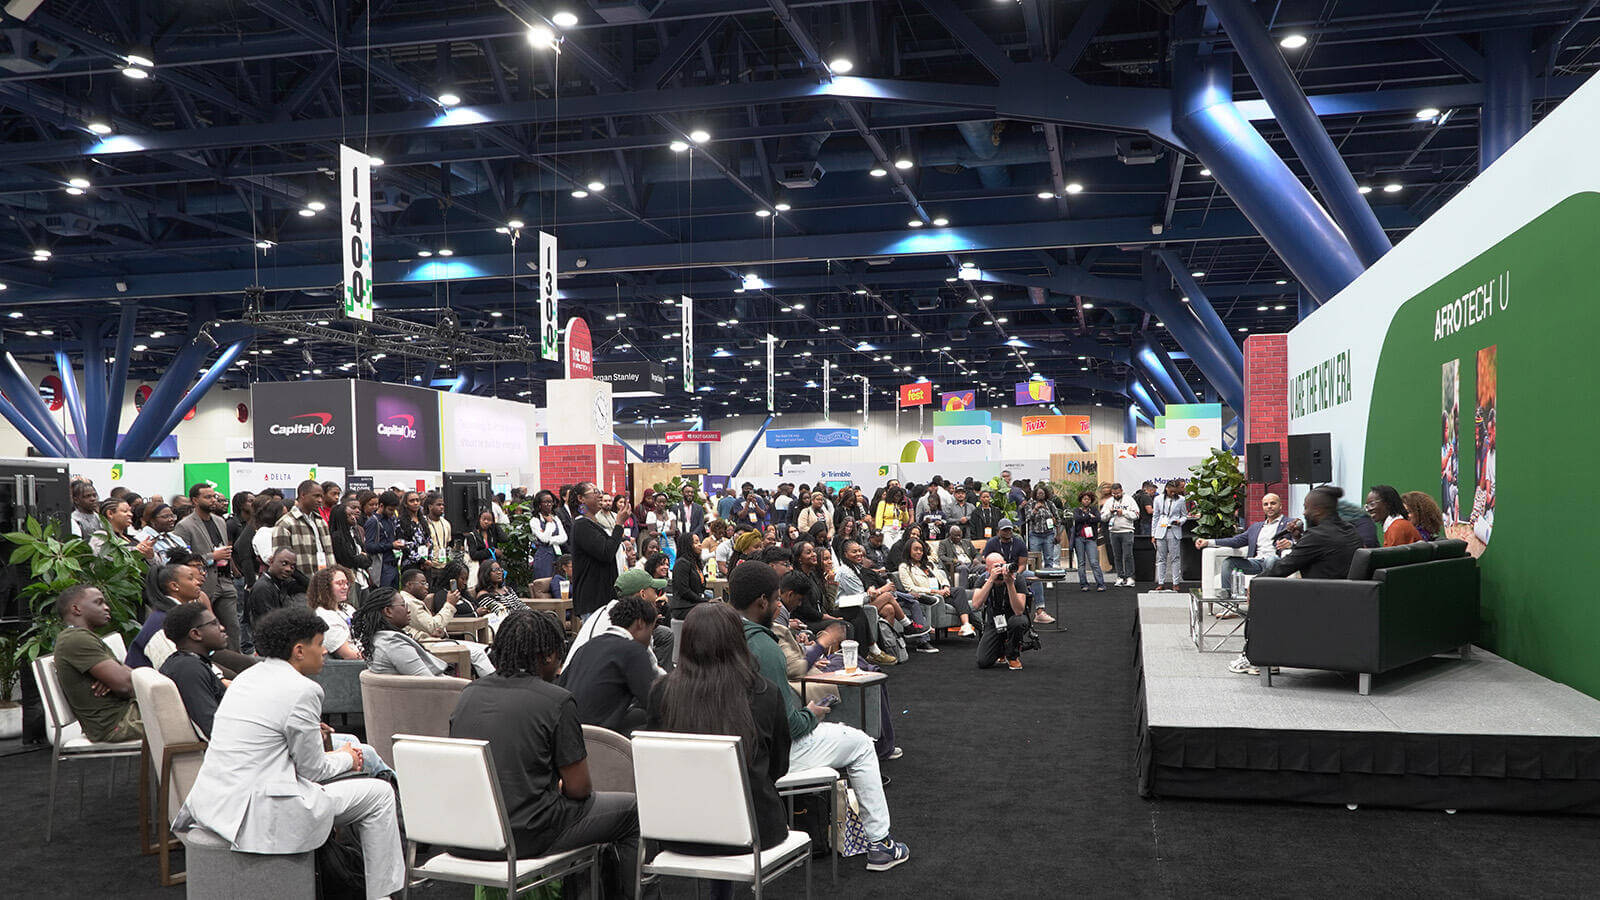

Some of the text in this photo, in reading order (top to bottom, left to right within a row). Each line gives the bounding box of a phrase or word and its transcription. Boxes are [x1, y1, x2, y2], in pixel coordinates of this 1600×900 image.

[350, 166, 363, 303] 1400
[1434, 270, 1509, 341] AFROTECH U
[613, 373, 640, 382] Stanley
[1295, 373, 1304, 418] ARE
[1306, 366, 1317, 415] THE
[1319, 357, 1335, 411] NEW
[1337, 349, 1351, 405] ERA
[908, 390, 924, 401] fest
[271, 473, 291, 481] DELTA
[828, 470, 851, 478] Trimble
